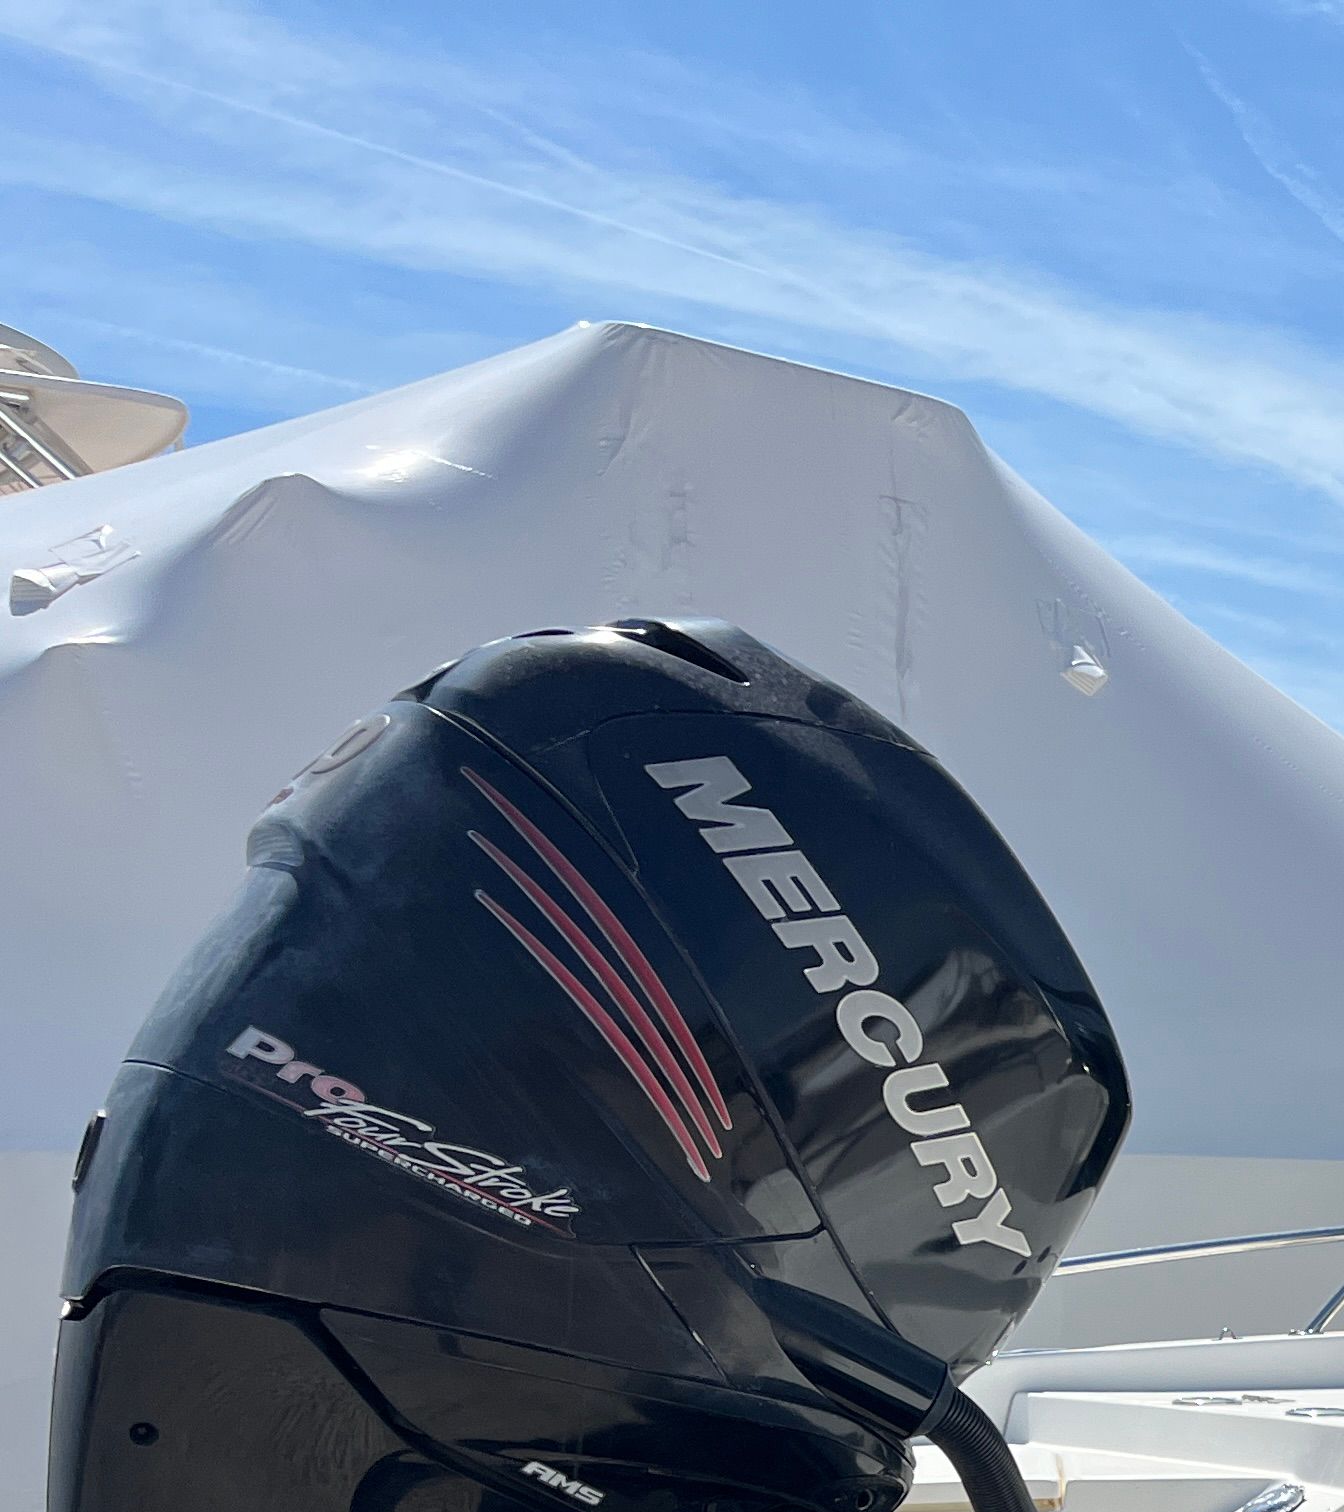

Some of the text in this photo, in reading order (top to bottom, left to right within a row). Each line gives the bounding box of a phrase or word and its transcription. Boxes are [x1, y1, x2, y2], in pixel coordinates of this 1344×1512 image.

[643, 755, 1032, 1258] MERCURY
[225, 1024, 365, 1104] Pro
[325, 1125, 532, 1226] SUPERCHARGED
[521, 1461, 604, 1505] AMS
